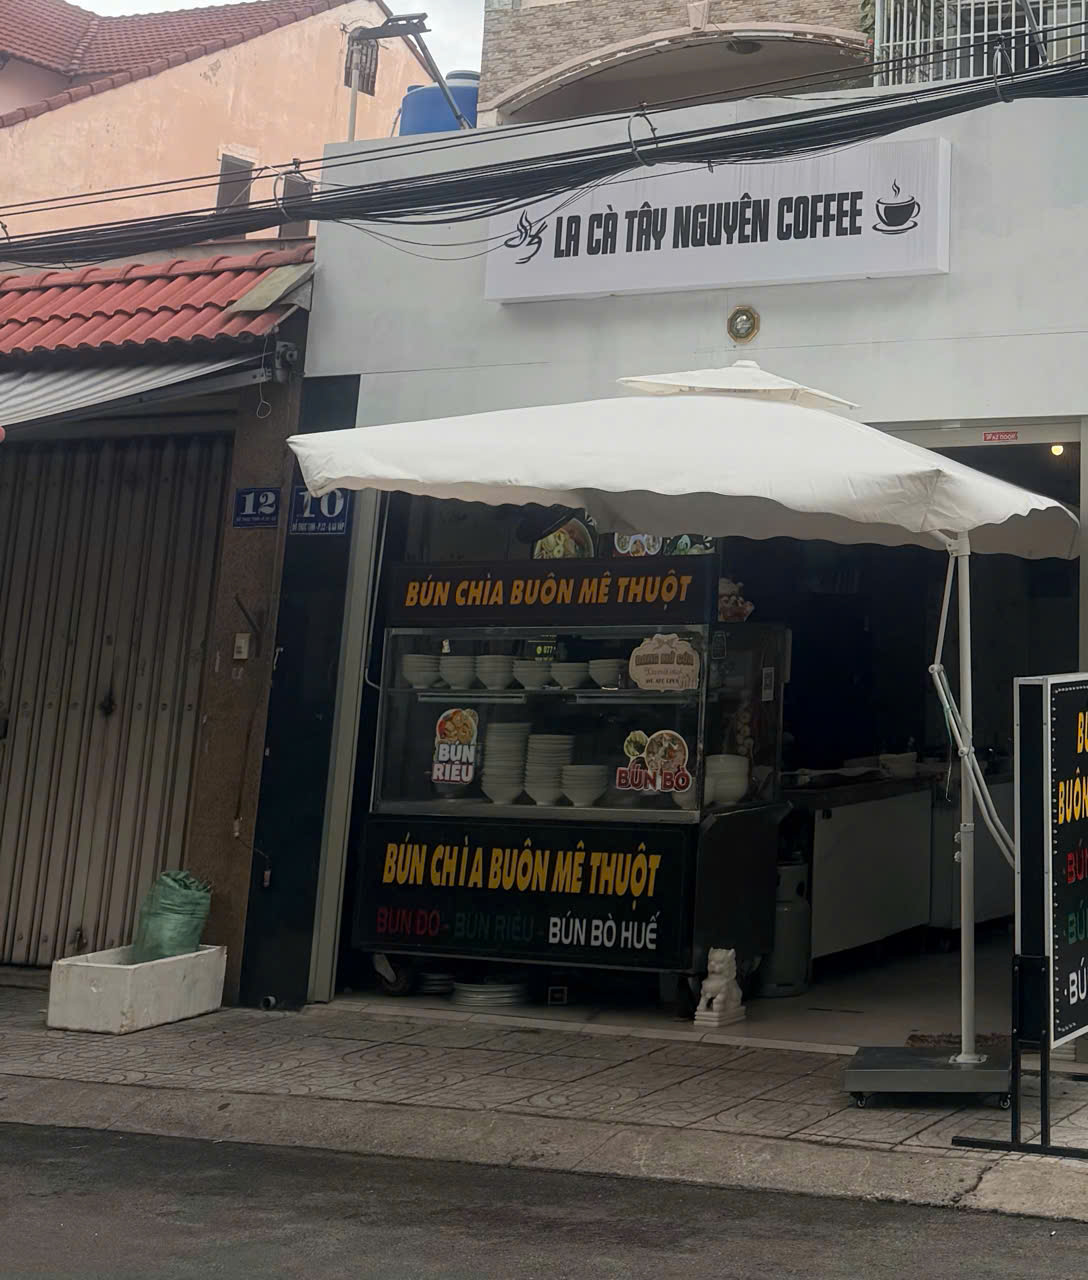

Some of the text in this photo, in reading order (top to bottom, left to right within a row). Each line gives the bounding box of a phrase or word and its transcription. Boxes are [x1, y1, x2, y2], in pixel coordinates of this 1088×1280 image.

[553, 190, 863, 259] LA CÀ TÂY NGUYÊN COFFEE
[240, 491, 277, 516] 12
[298, 489, 345, 518] 10
[405, 574, 451, 607] BÚN
[509, 571, 574, 606] BUÔN
[577, 570, 612, 604] MÊ
[616, 569, 693, 611] THUỘT
[438, 742, 475, 764] BÚN
[433, 761, 474, 784] RIÊU
[617, 764, 656, 790] BÚN
[382, 832, 427, 885] BÚN
[488, 837, 551, 893] BUÔN
[551, 840, 586, 894] MÊ
[589, 842, 662, 911] THUỘT
[548, 910, 586, 946] BÚN
[589, 912, 617, 948] BÒ
[620, 910, 662, 950] HUẾ
